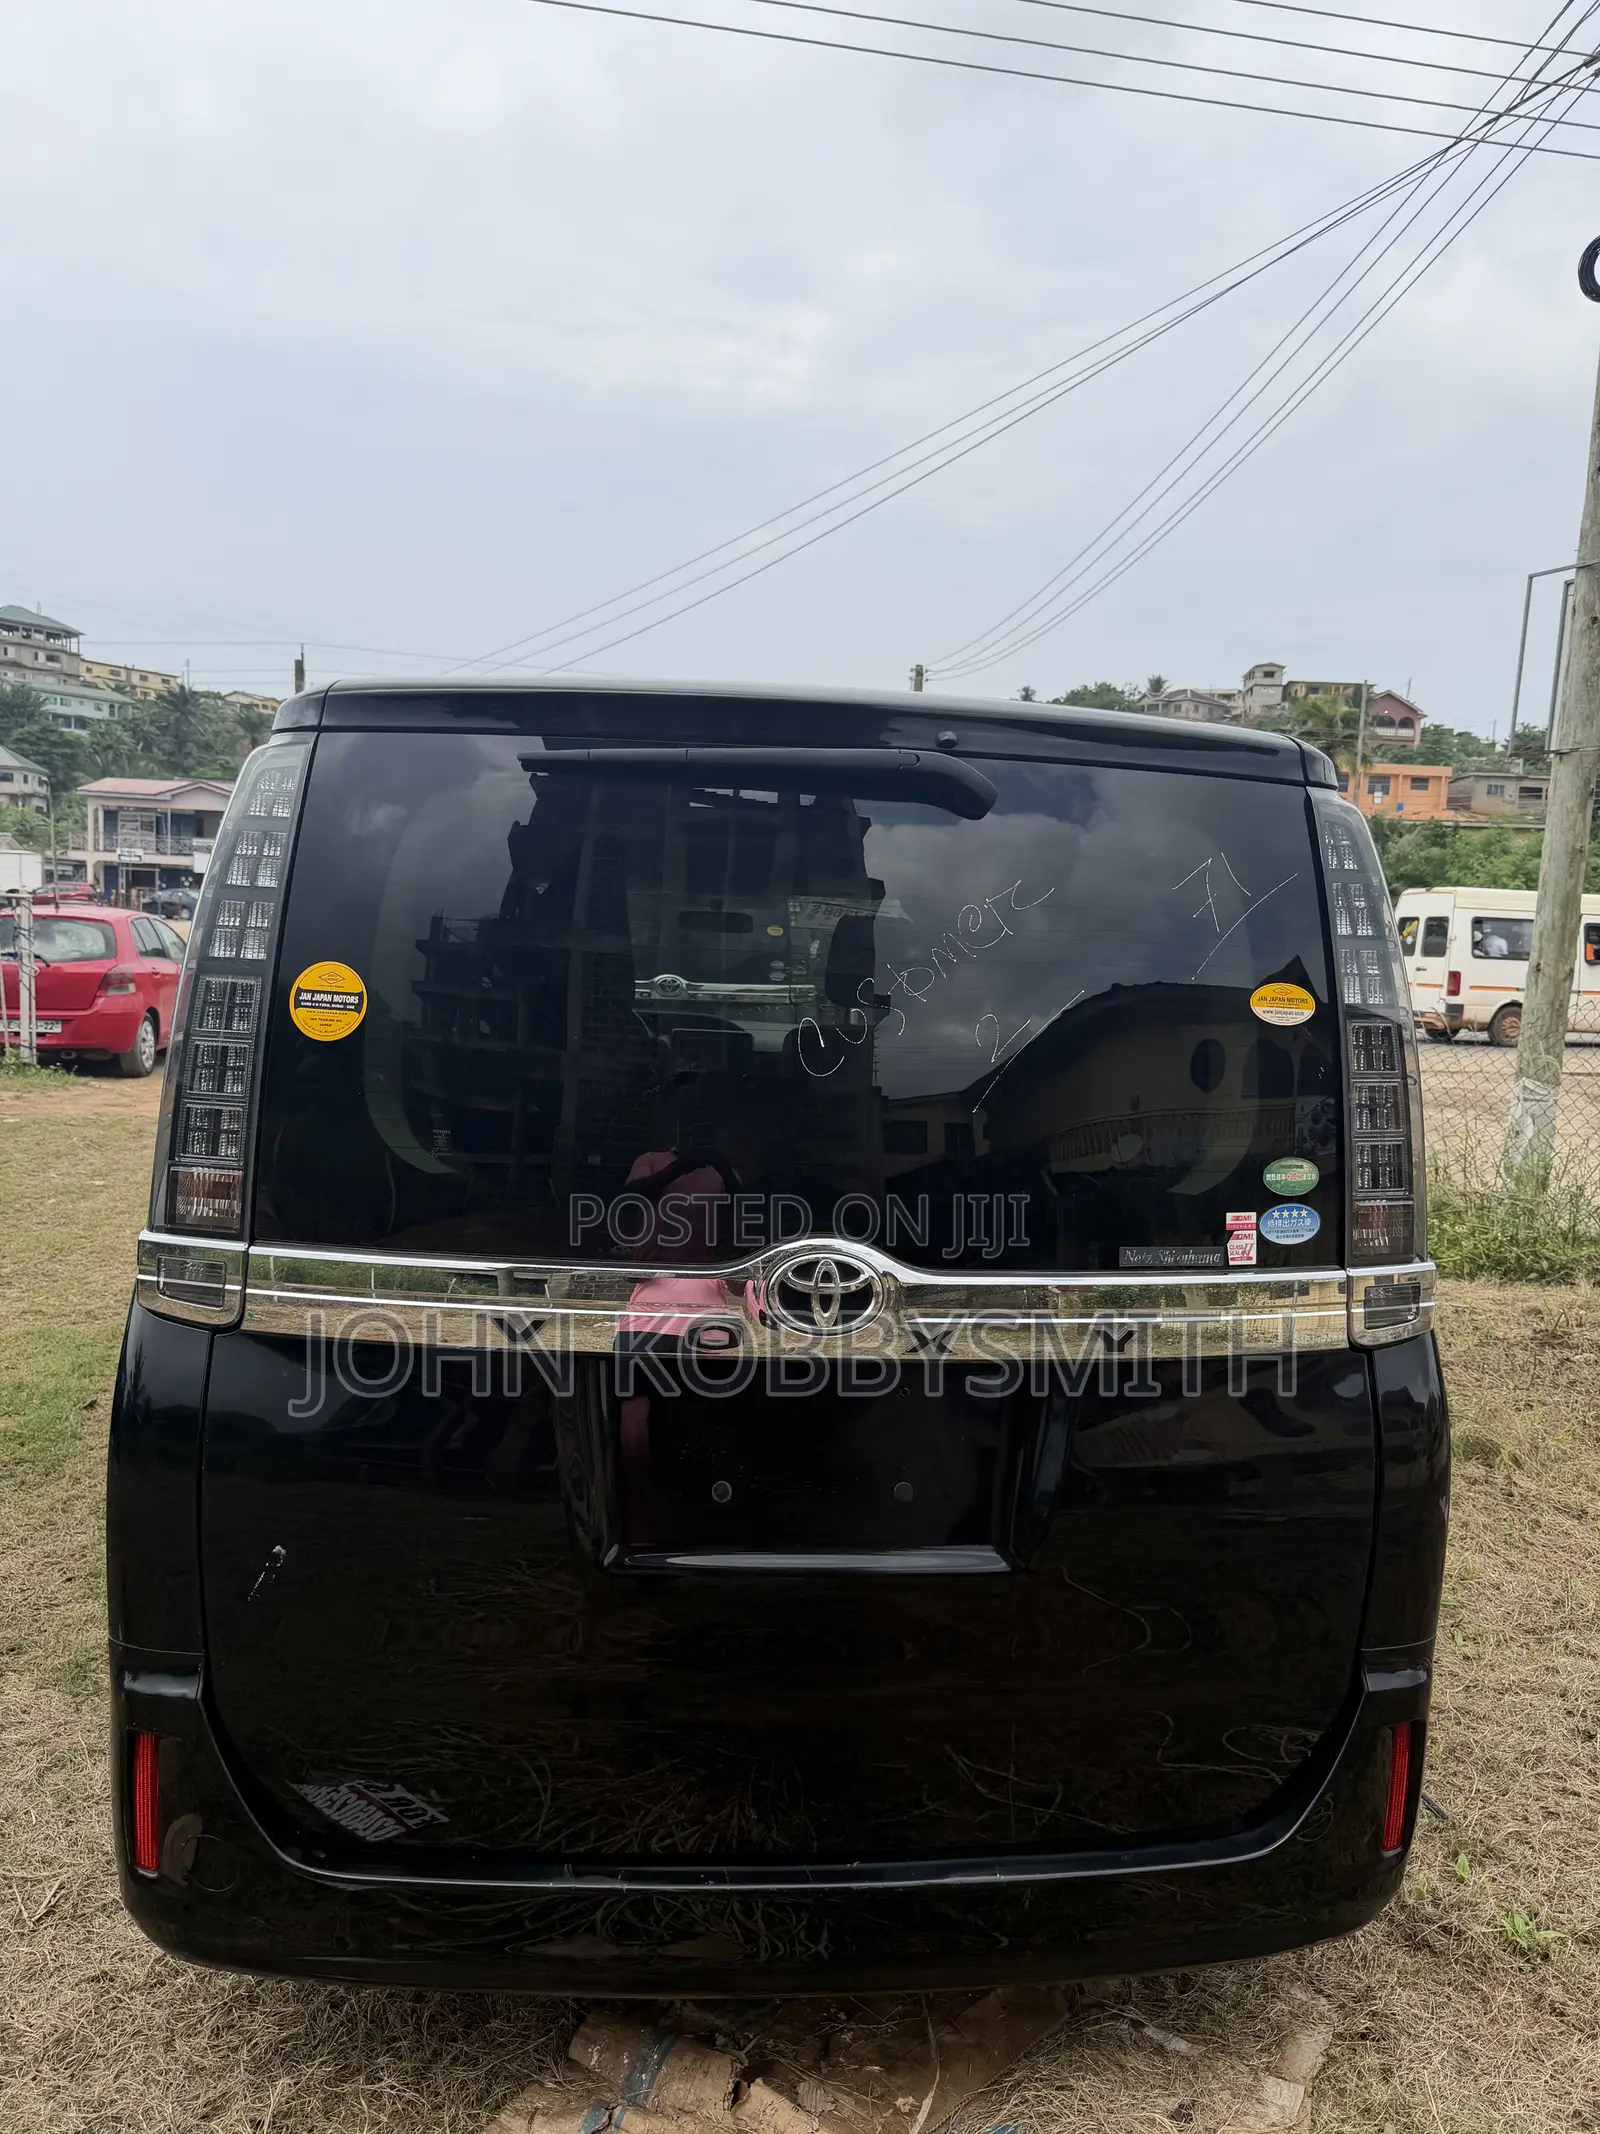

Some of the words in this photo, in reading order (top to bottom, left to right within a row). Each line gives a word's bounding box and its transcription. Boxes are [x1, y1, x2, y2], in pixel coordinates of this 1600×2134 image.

[299, 992, 312, 1001] JAN
[312, 993, 332, 1002] JAPAN
[332, 994, 359, 1004] MOTORS
[1287, 997, 1309, 1005] MOTORS
